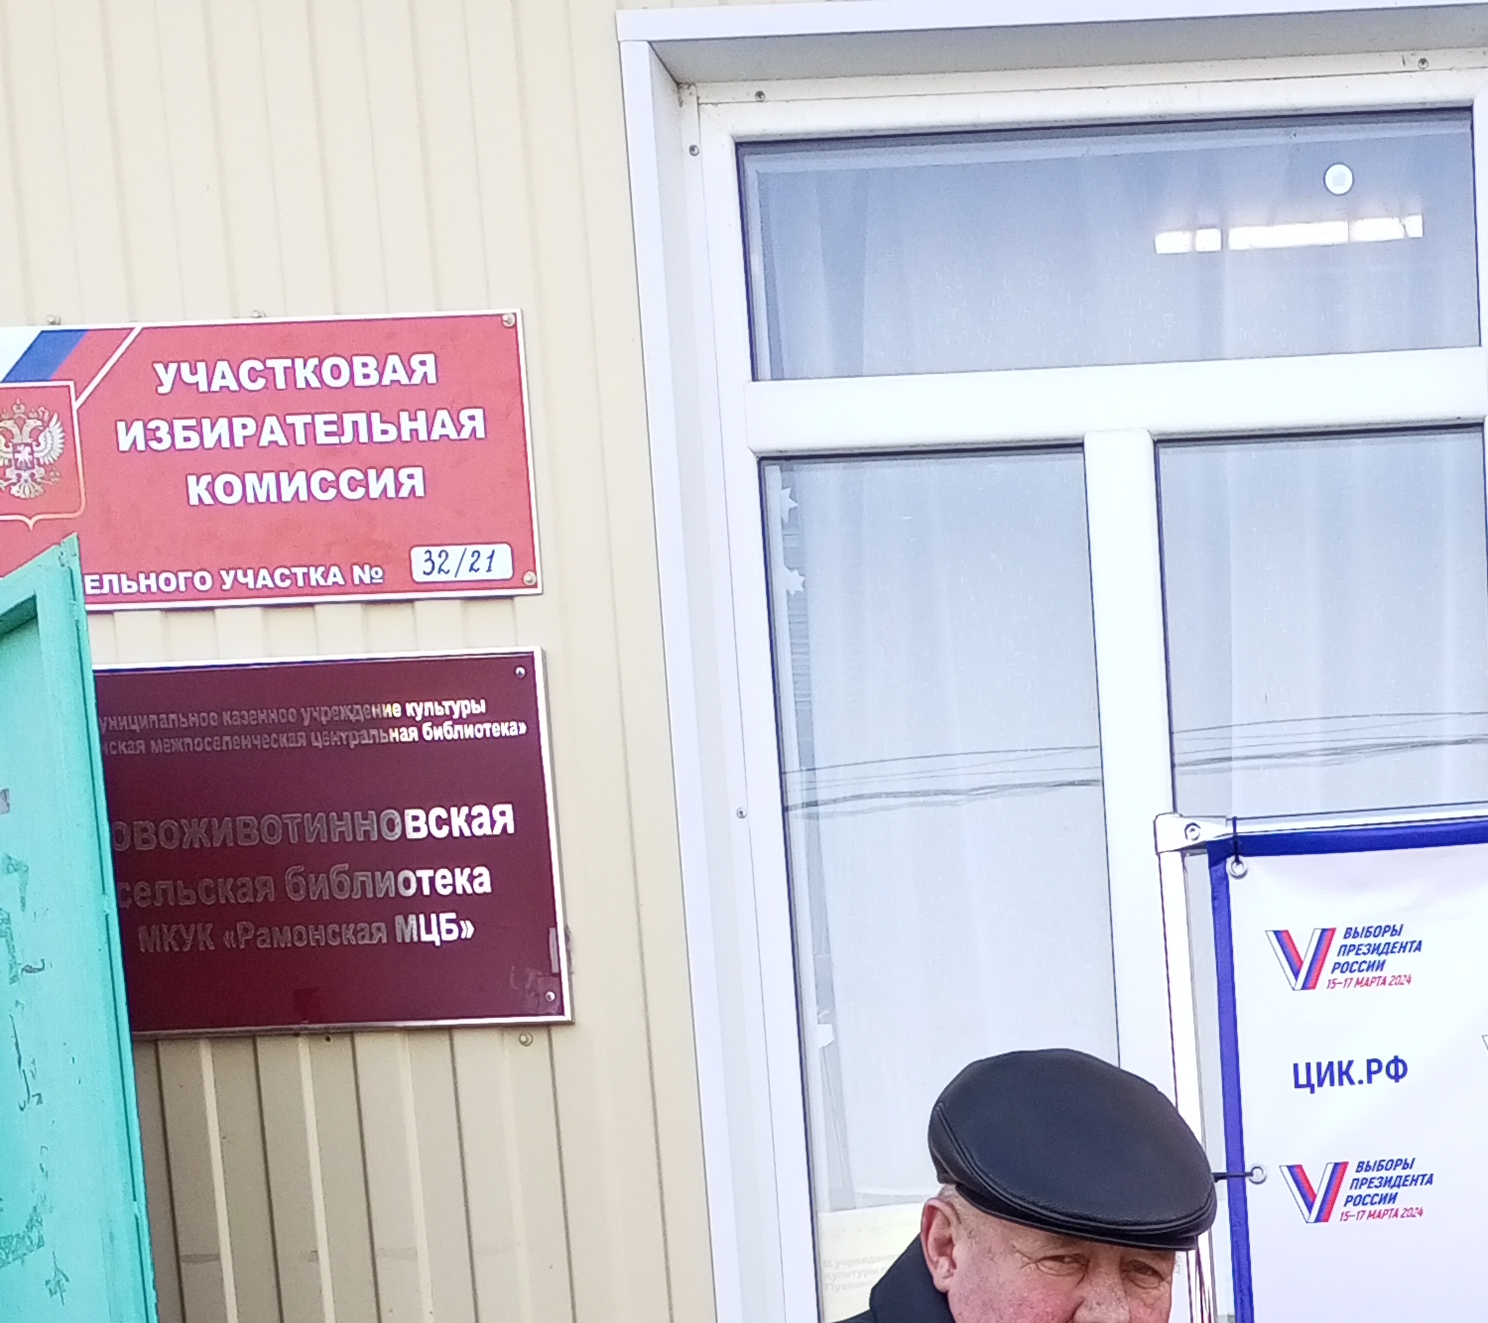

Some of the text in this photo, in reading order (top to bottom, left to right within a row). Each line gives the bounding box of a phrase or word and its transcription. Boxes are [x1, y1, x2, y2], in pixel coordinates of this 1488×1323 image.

[154, 353, 437, 394] УЧАСТКОВАЯ
[116, 408, 486, 452] ИЗБИРАТЕЛЬНАЯ
[187, 466, 425, 506] КОМИССИЯ
[220, 566, 346, 591] УЧАСТКА
[352, 564, 384, 585] №
[422, 548, 496, 578] 32/21
[222, 706, 297, 727] казенное
[300, 703, 402, 727] учреждение
[406, 698, 486, 721] культуры
[151, 731, 306, 755] межпоселенческая
[311, 725, 419, 749] центральная
[422, 720, 528, 742] библиотека»
[112, 803, 515, 852] овоживотинновская
[118, 863, 492, 909] сельская библиотека
[138, 911, 476, 953] МКУК «Рамонская МЦБ»
[1343, 924, 1404, 939] ВЫБОРЫ
[1337, 940, 1422, 957] ПРЕЗИДЕНТА
[1331, 959, 1386, 974] РОССИИ
[1354, 976, 1387, 987] МАРТА
[1388, 975, 1411, 986] 2024
[1293, 1055, 1408, 1094] ЦИК.РФ
[1350, 1173, 1434, 1190] ПРЕЗИДЕНТА
[1356, 1158, 1416, 1173] ВЫБОРЫ
[1344, 1192, 1398, 1207] РОССИИ
[1366, 1208, 1399, 1220] МАРТА
[1400, 1207, 1423, 1218] 2024
